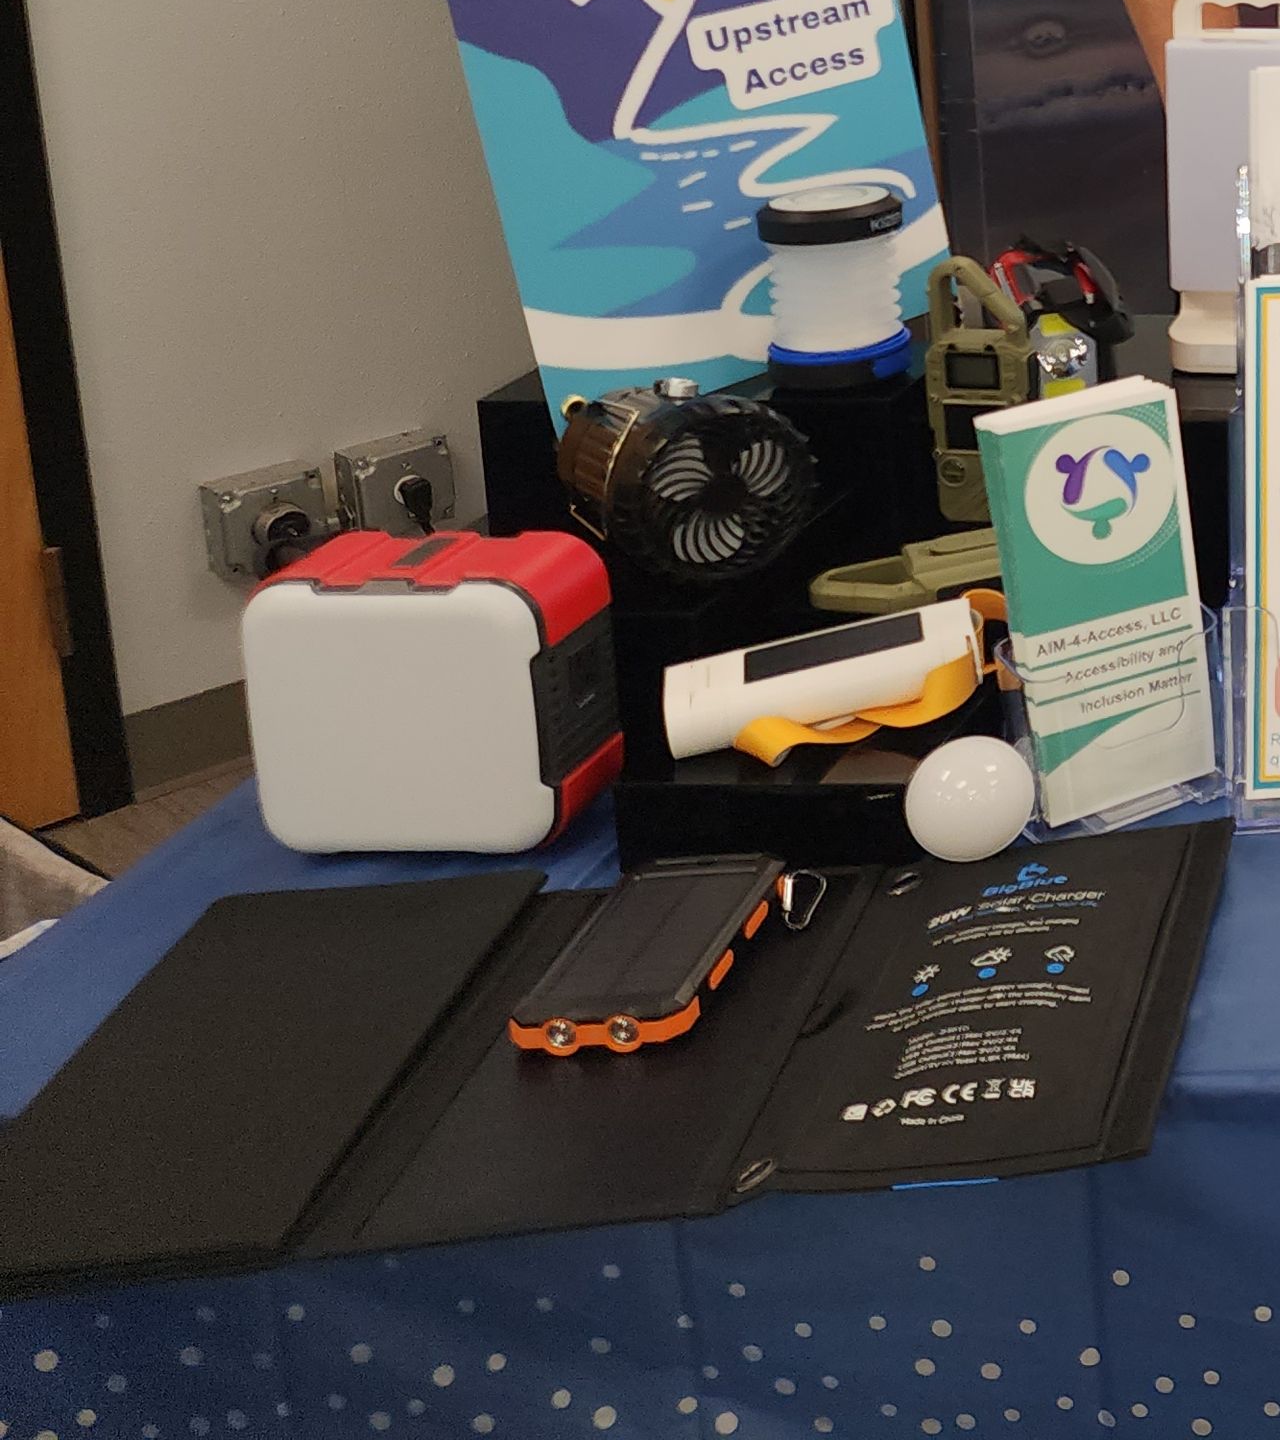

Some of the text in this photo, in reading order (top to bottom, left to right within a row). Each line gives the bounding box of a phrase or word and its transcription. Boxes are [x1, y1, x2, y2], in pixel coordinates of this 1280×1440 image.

[705, 0, 870, 53] Upstream
[745, 48, 865, 94] Access
[1036, 607, 1182, 658] AIM-4-Access, LLC
[1064, 640, 1184, 684] Accessibility and
[1080, 688, 1144, 714] Inclusion
[1029, 890, 1105, 903] Charger
